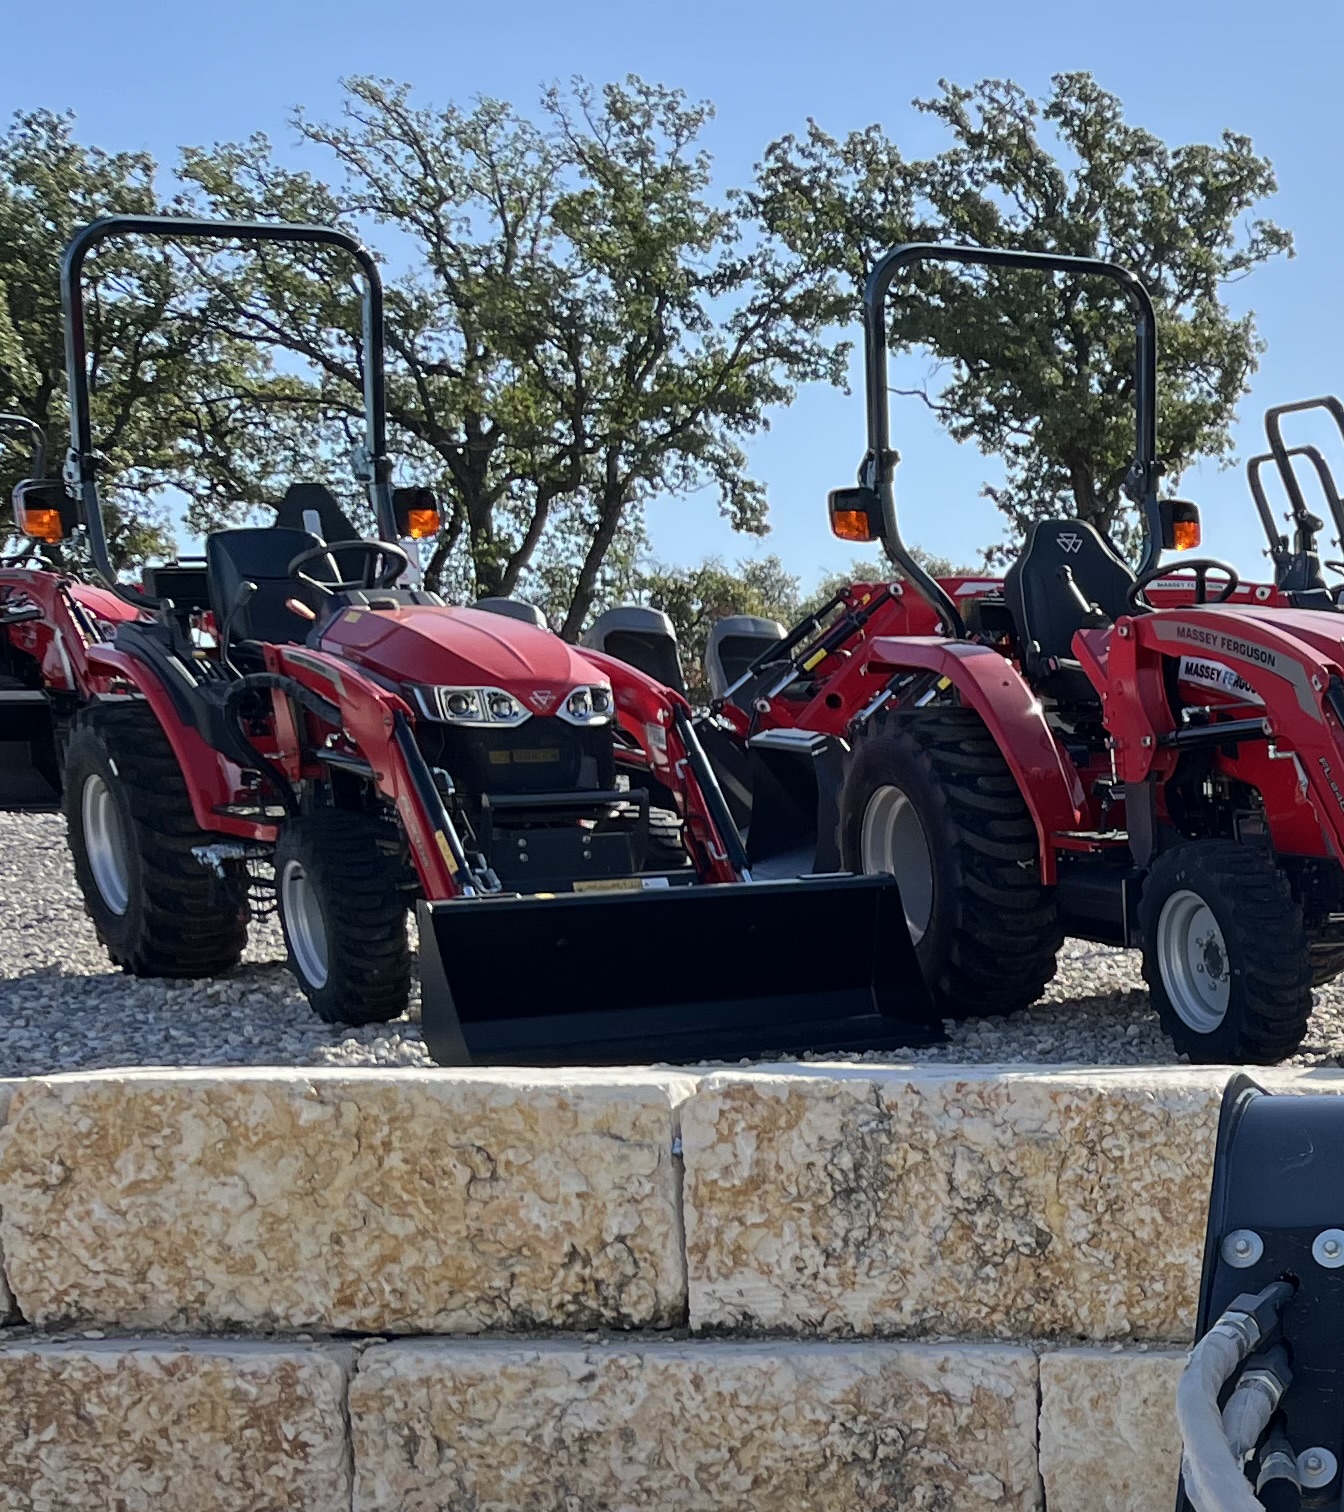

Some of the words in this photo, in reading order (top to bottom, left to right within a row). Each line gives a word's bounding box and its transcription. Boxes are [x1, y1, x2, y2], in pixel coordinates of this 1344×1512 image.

[1177, 625, 1218, 647] MASSEY
[1220, 636, 1276, 668] FERGUSON
[1184, 661, 1222, 682] MASSEY
